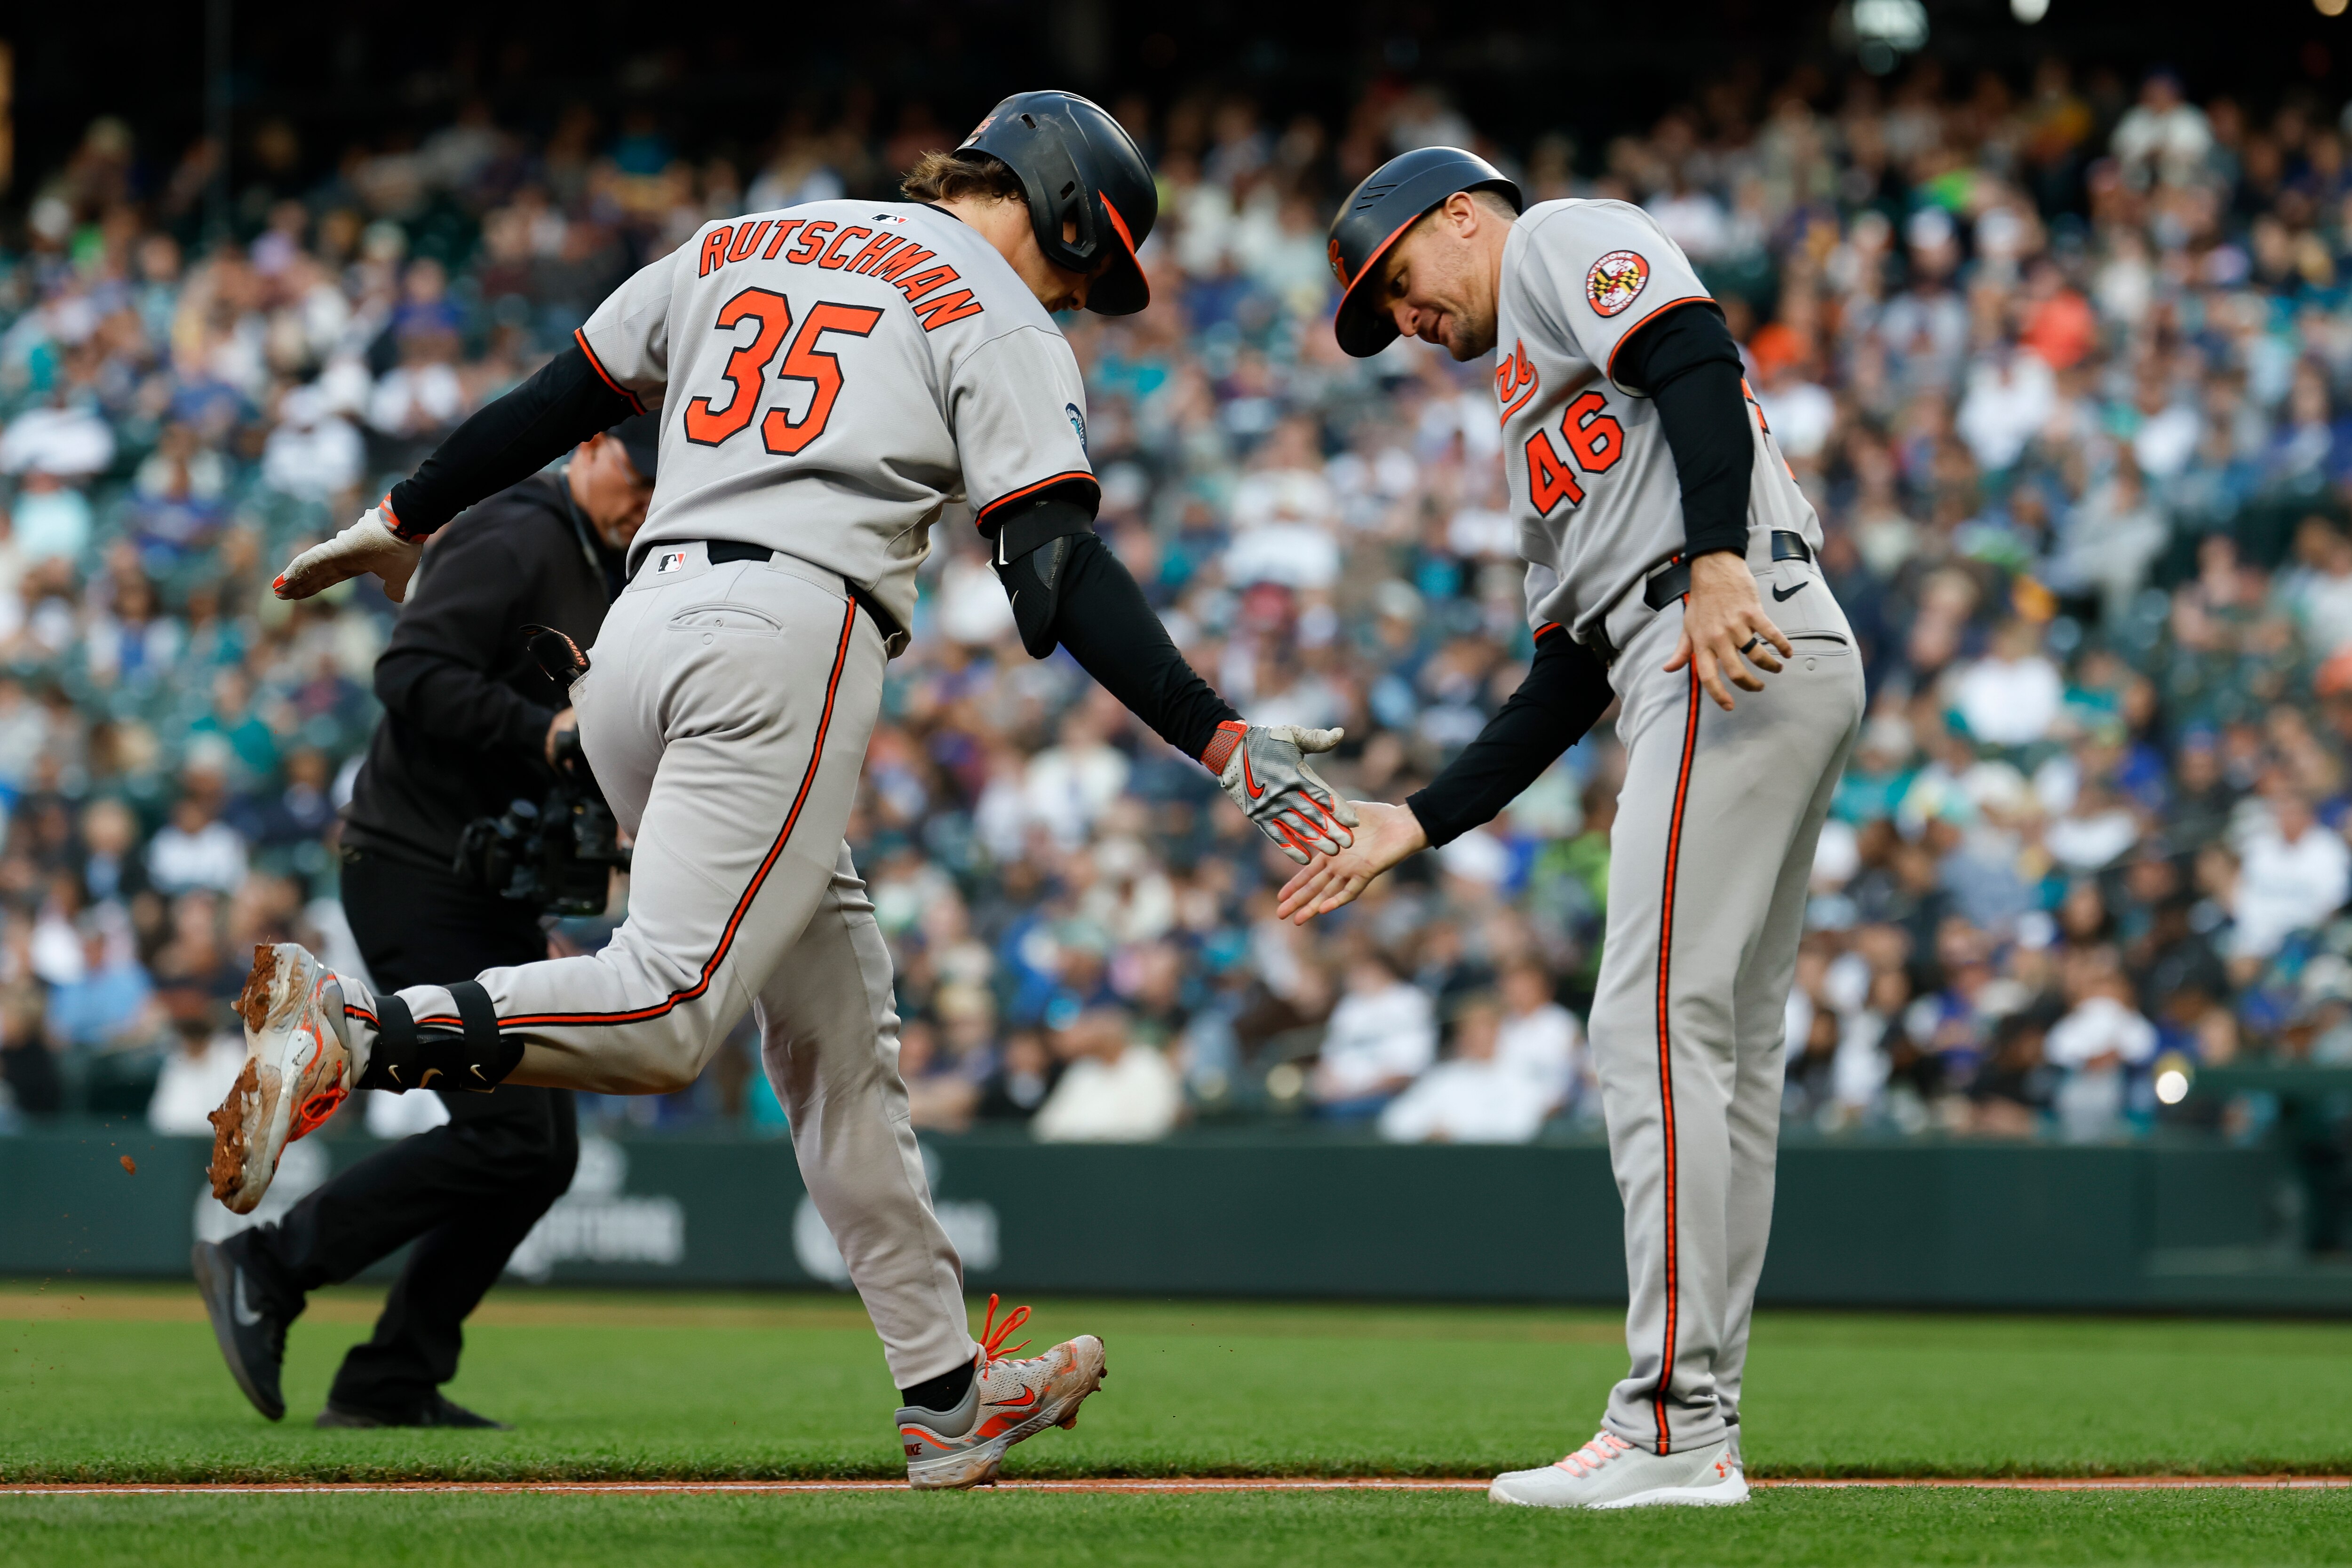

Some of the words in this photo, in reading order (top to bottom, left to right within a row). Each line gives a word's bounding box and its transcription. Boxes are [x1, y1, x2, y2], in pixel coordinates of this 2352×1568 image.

[699, 220, 984, 332] RUTSCHMAN
[1587, 252, 1635, 300] BALTIMORE
[1609, 276, 1646, 313] ORIOLES
[684, 286, 885, 456] 35
[1525, 390, 1624, 518] 46
